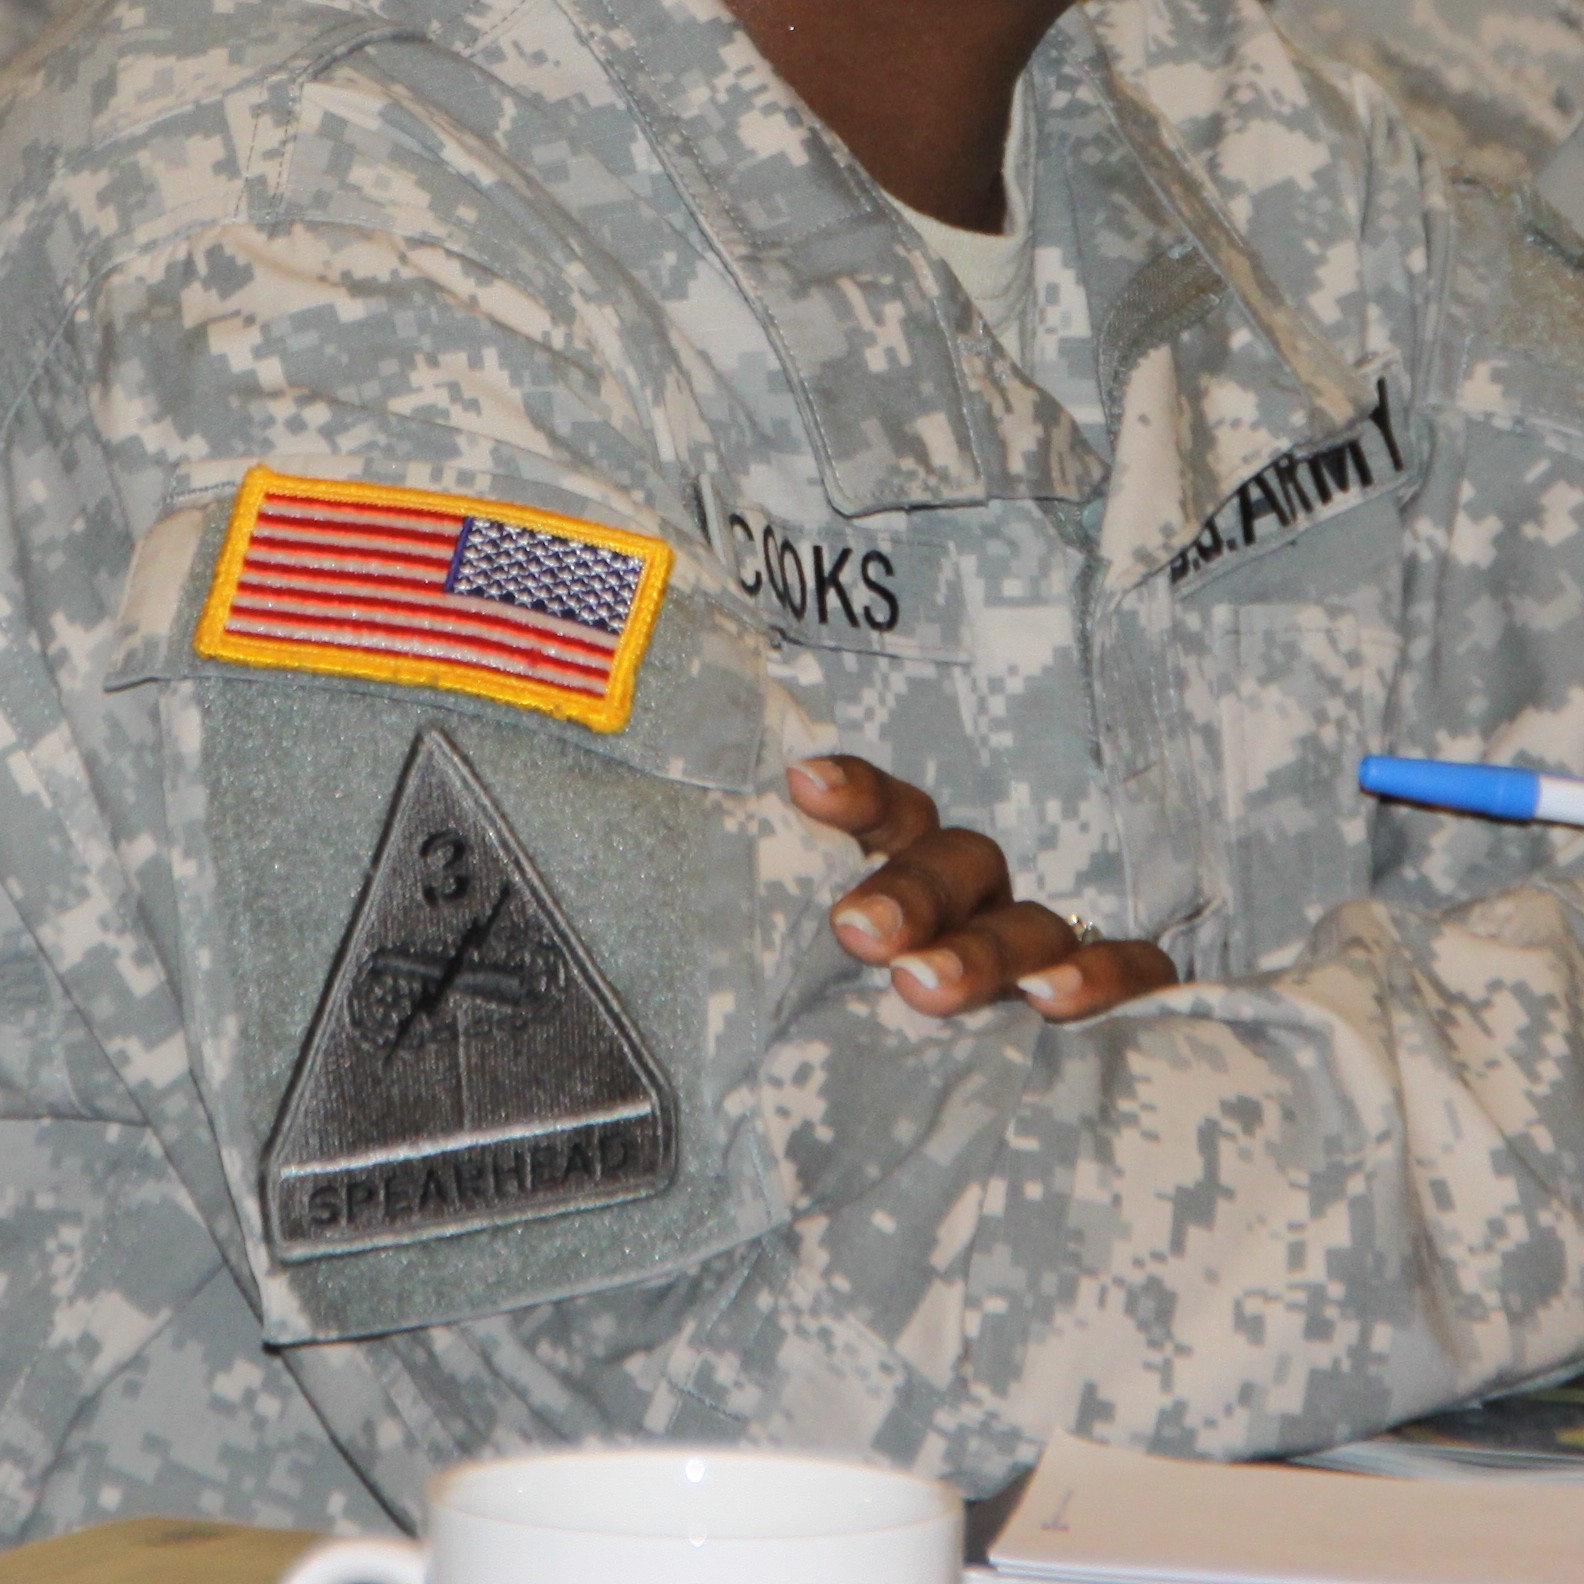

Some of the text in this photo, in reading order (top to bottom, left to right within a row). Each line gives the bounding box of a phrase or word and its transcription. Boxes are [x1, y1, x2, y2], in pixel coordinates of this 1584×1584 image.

[1238, 376, 1405, 547] ARMY
[728, 513, 900, 633] COOKS
[420, 827, 469, 911] 3
[308, 1133, 630, 1225] SPEARHEAD
